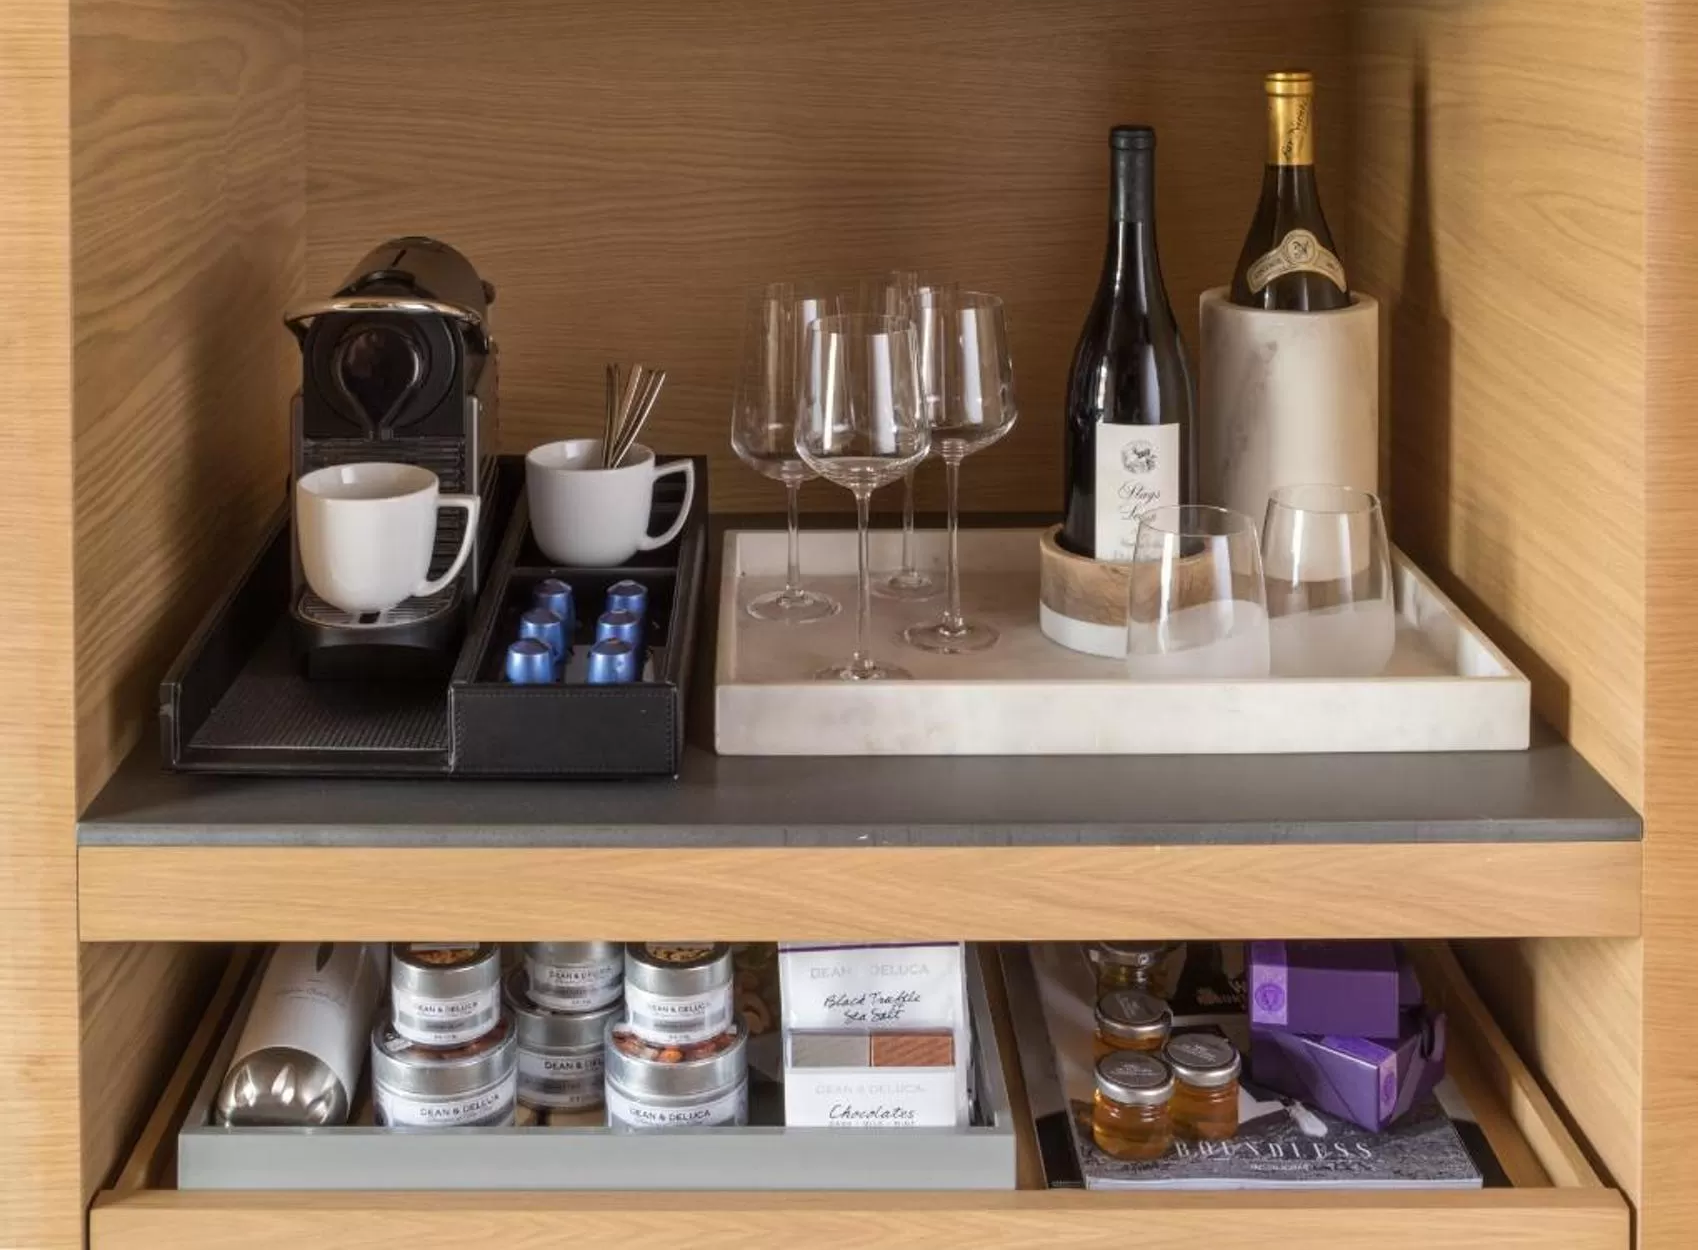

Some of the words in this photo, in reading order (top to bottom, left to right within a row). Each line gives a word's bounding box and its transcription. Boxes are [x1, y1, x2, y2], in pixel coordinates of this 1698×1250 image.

[810, 966, 851, 979] DEAN
[869, 964, 930, 977] DELUCA
[544, 1060, 574, 1071] DEAN
[829, 1103, 916, 1120] Chocolates
[1174, 1140, 1373, 1159] BOUNDLESS
